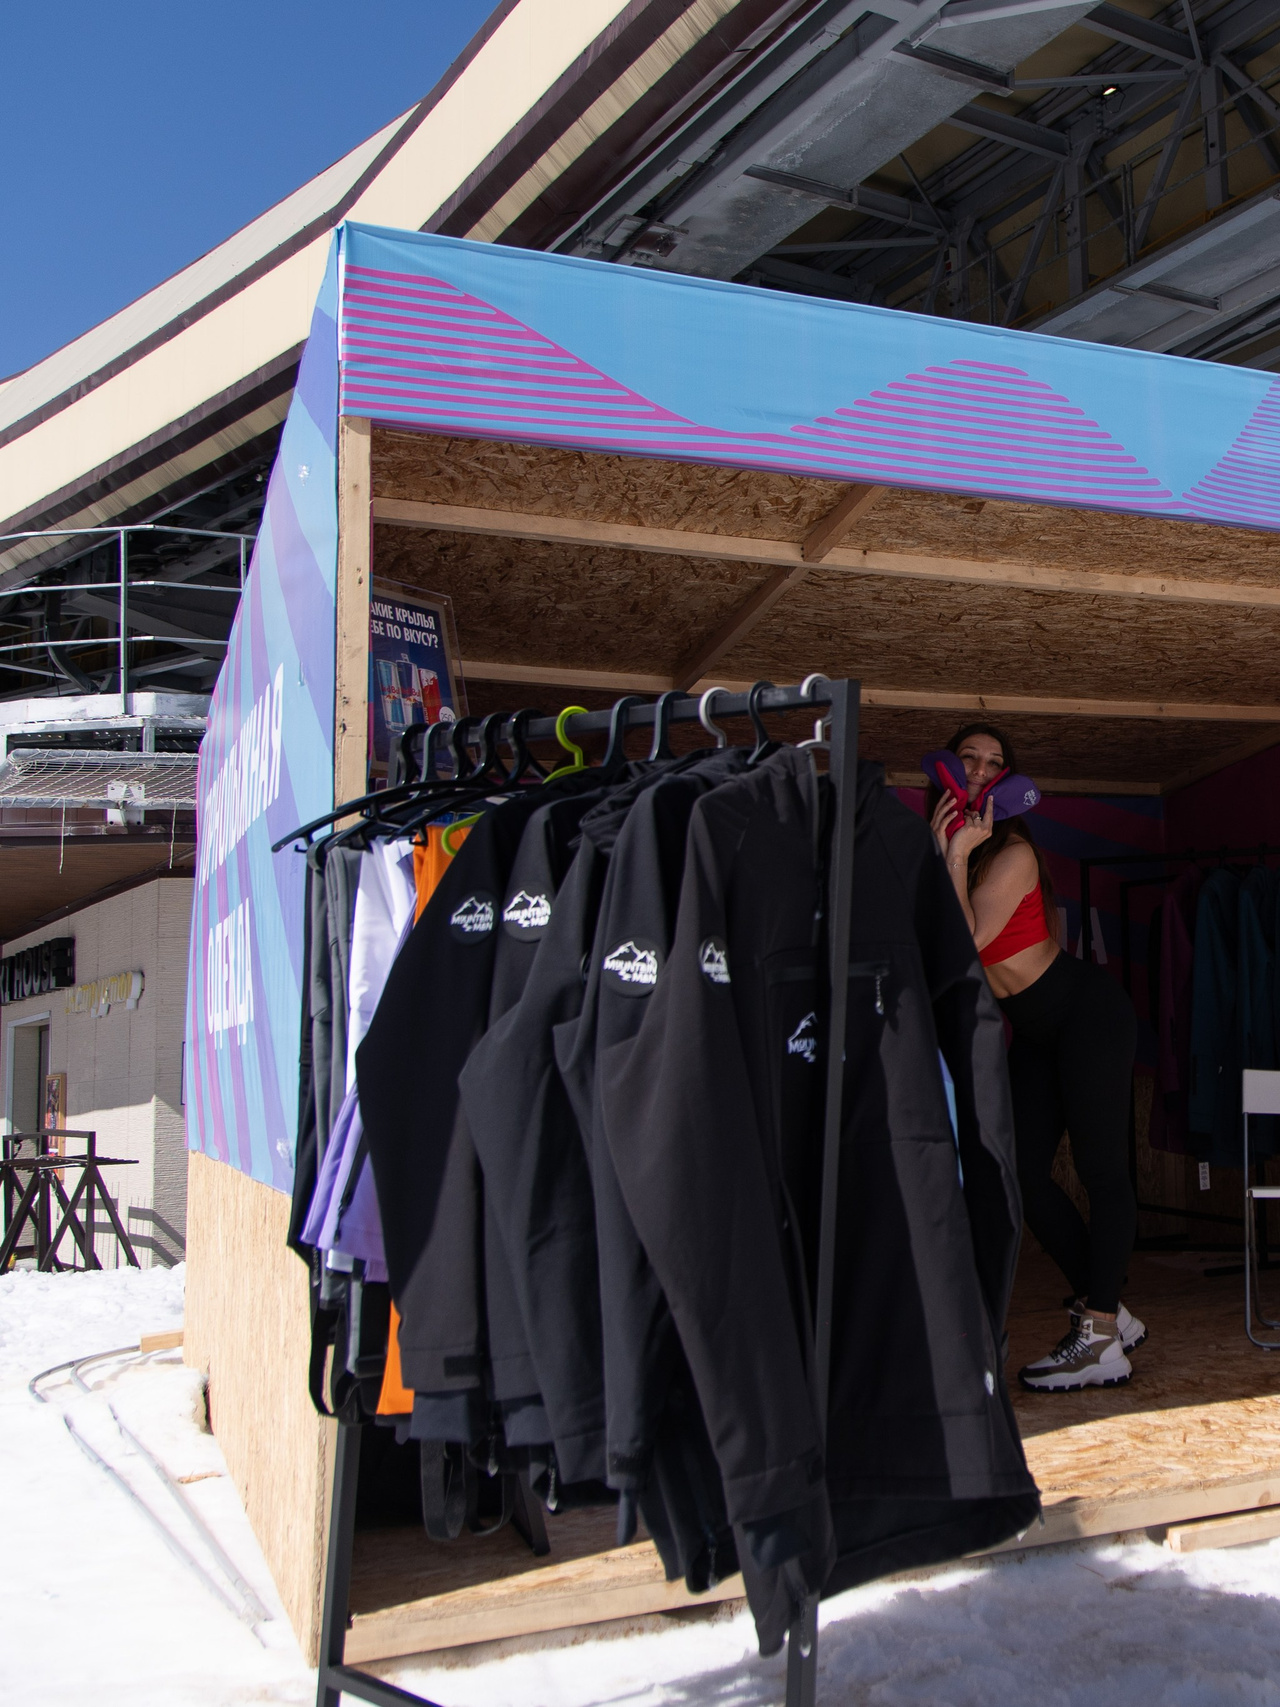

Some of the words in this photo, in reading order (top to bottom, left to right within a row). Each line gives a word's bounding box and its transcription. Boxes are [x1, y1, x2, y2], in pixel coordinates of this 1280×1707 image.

[396, 607, 436, 630] КРЫЛЬЯ
[386, 622, 401, 639] ПО
[404, 627, 439, 648] ВКУСУ?
[207, 896, 255, 1050] ОДЕЖДА
